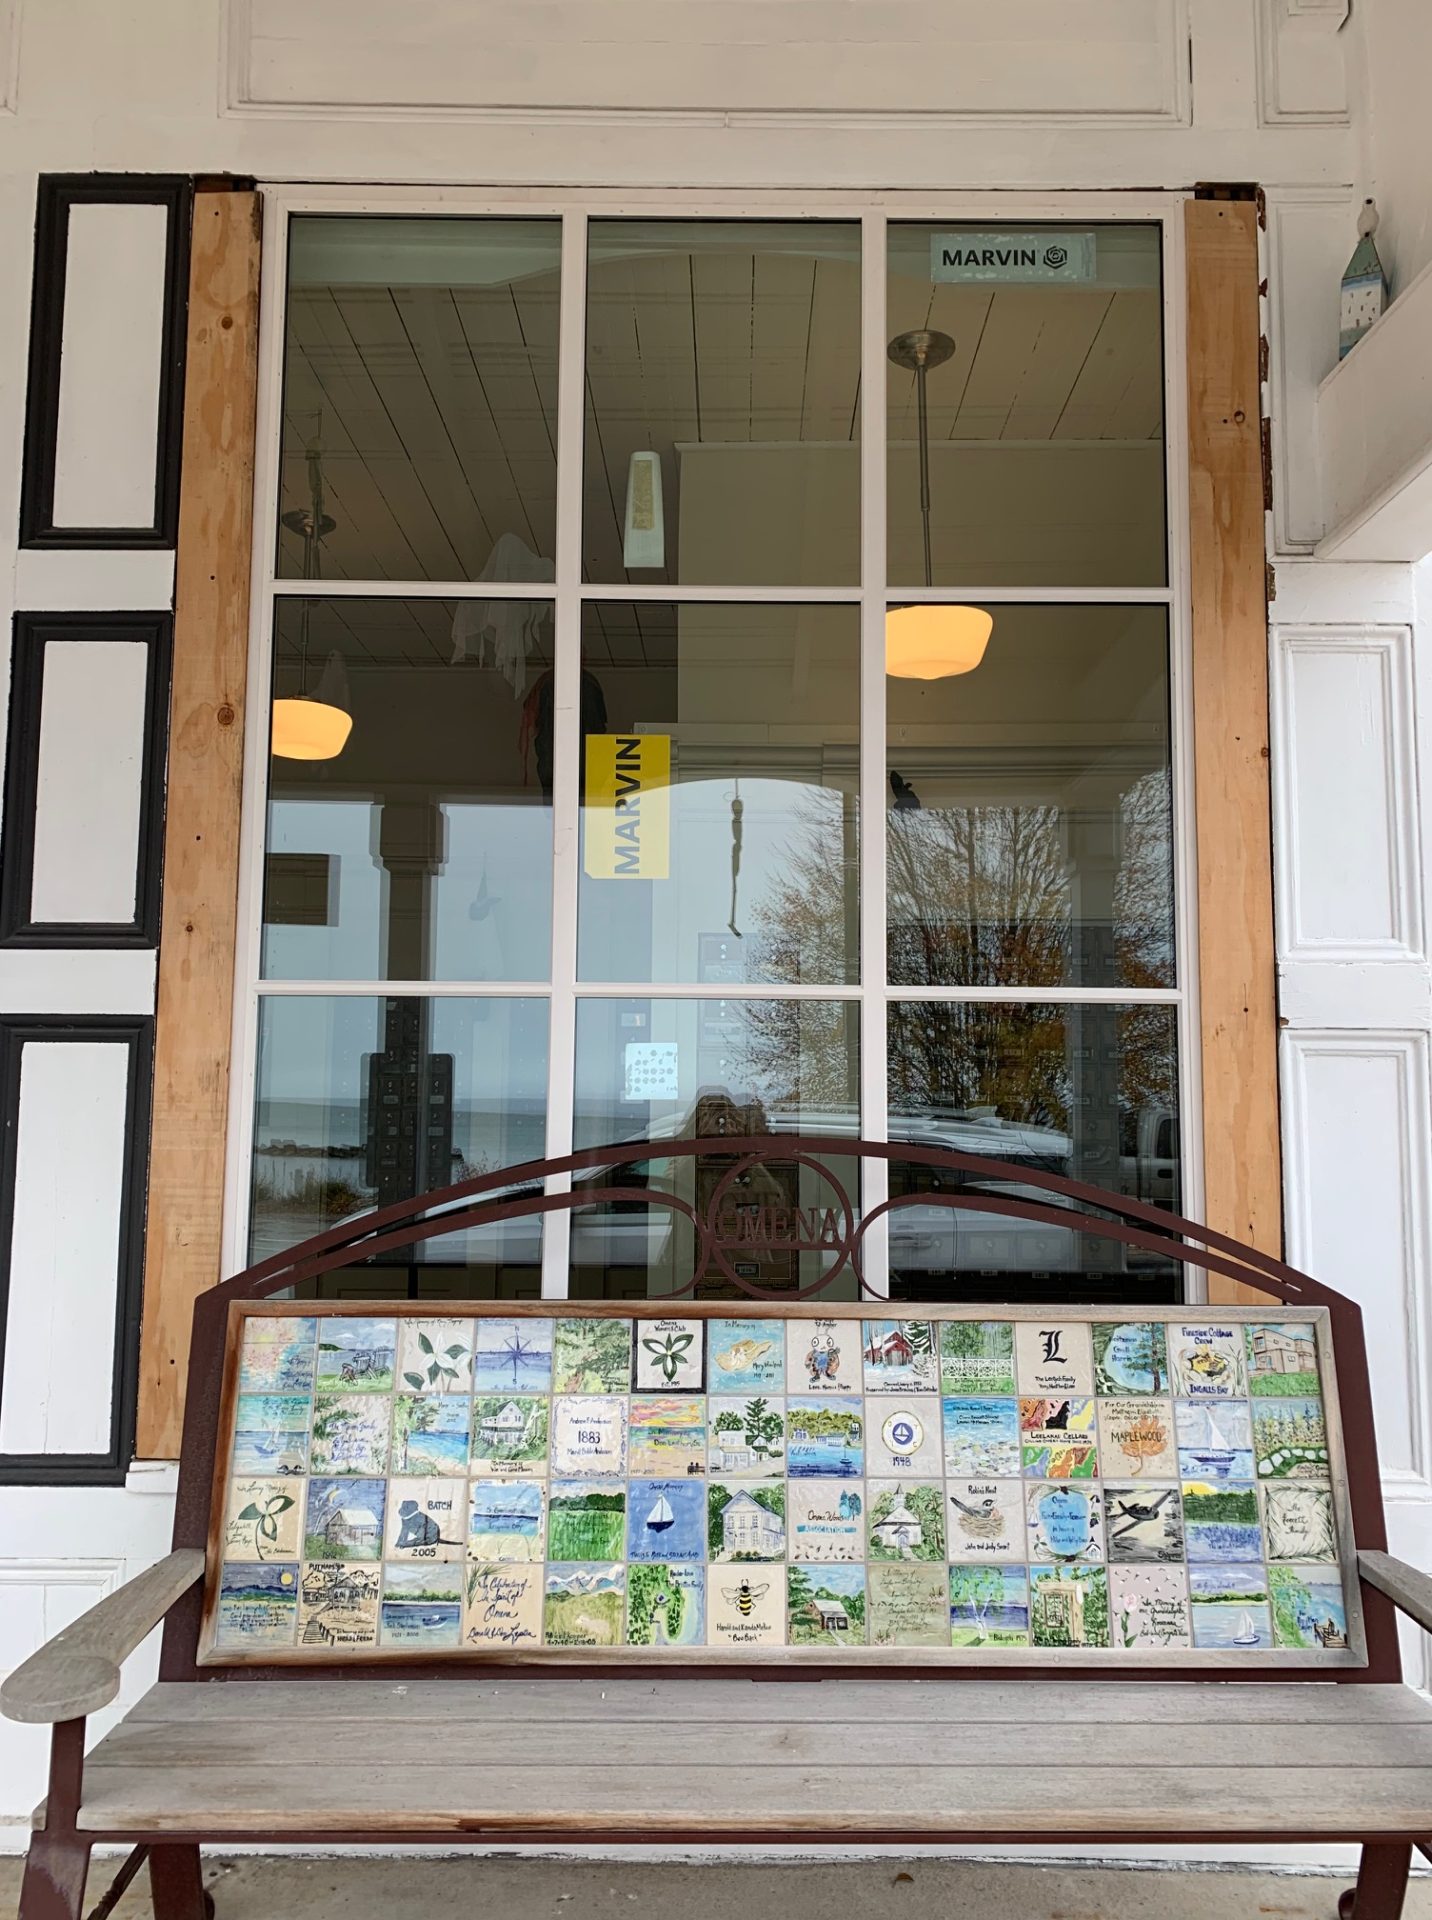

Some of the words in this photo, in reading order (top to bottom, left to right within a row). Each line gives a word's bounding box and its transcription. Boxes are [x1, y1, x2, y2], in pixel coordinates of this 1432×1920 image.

[942, 249, 1036, 266] MARVIN
[614, 738, 641, 874] MARVIN
[717, 1207, 842, 1243] OMENA
[1039, 1330, 1068, 1364] L
[578, 1430, 601, 1444] 1883
[1110, 1431, 1163, 1443] MAPLEWOOD
[893, 1456, 911, 1467] 1948
[427, 1500, 453, 1511] BATCH
[411, 1549, 436, 1557] 2005
